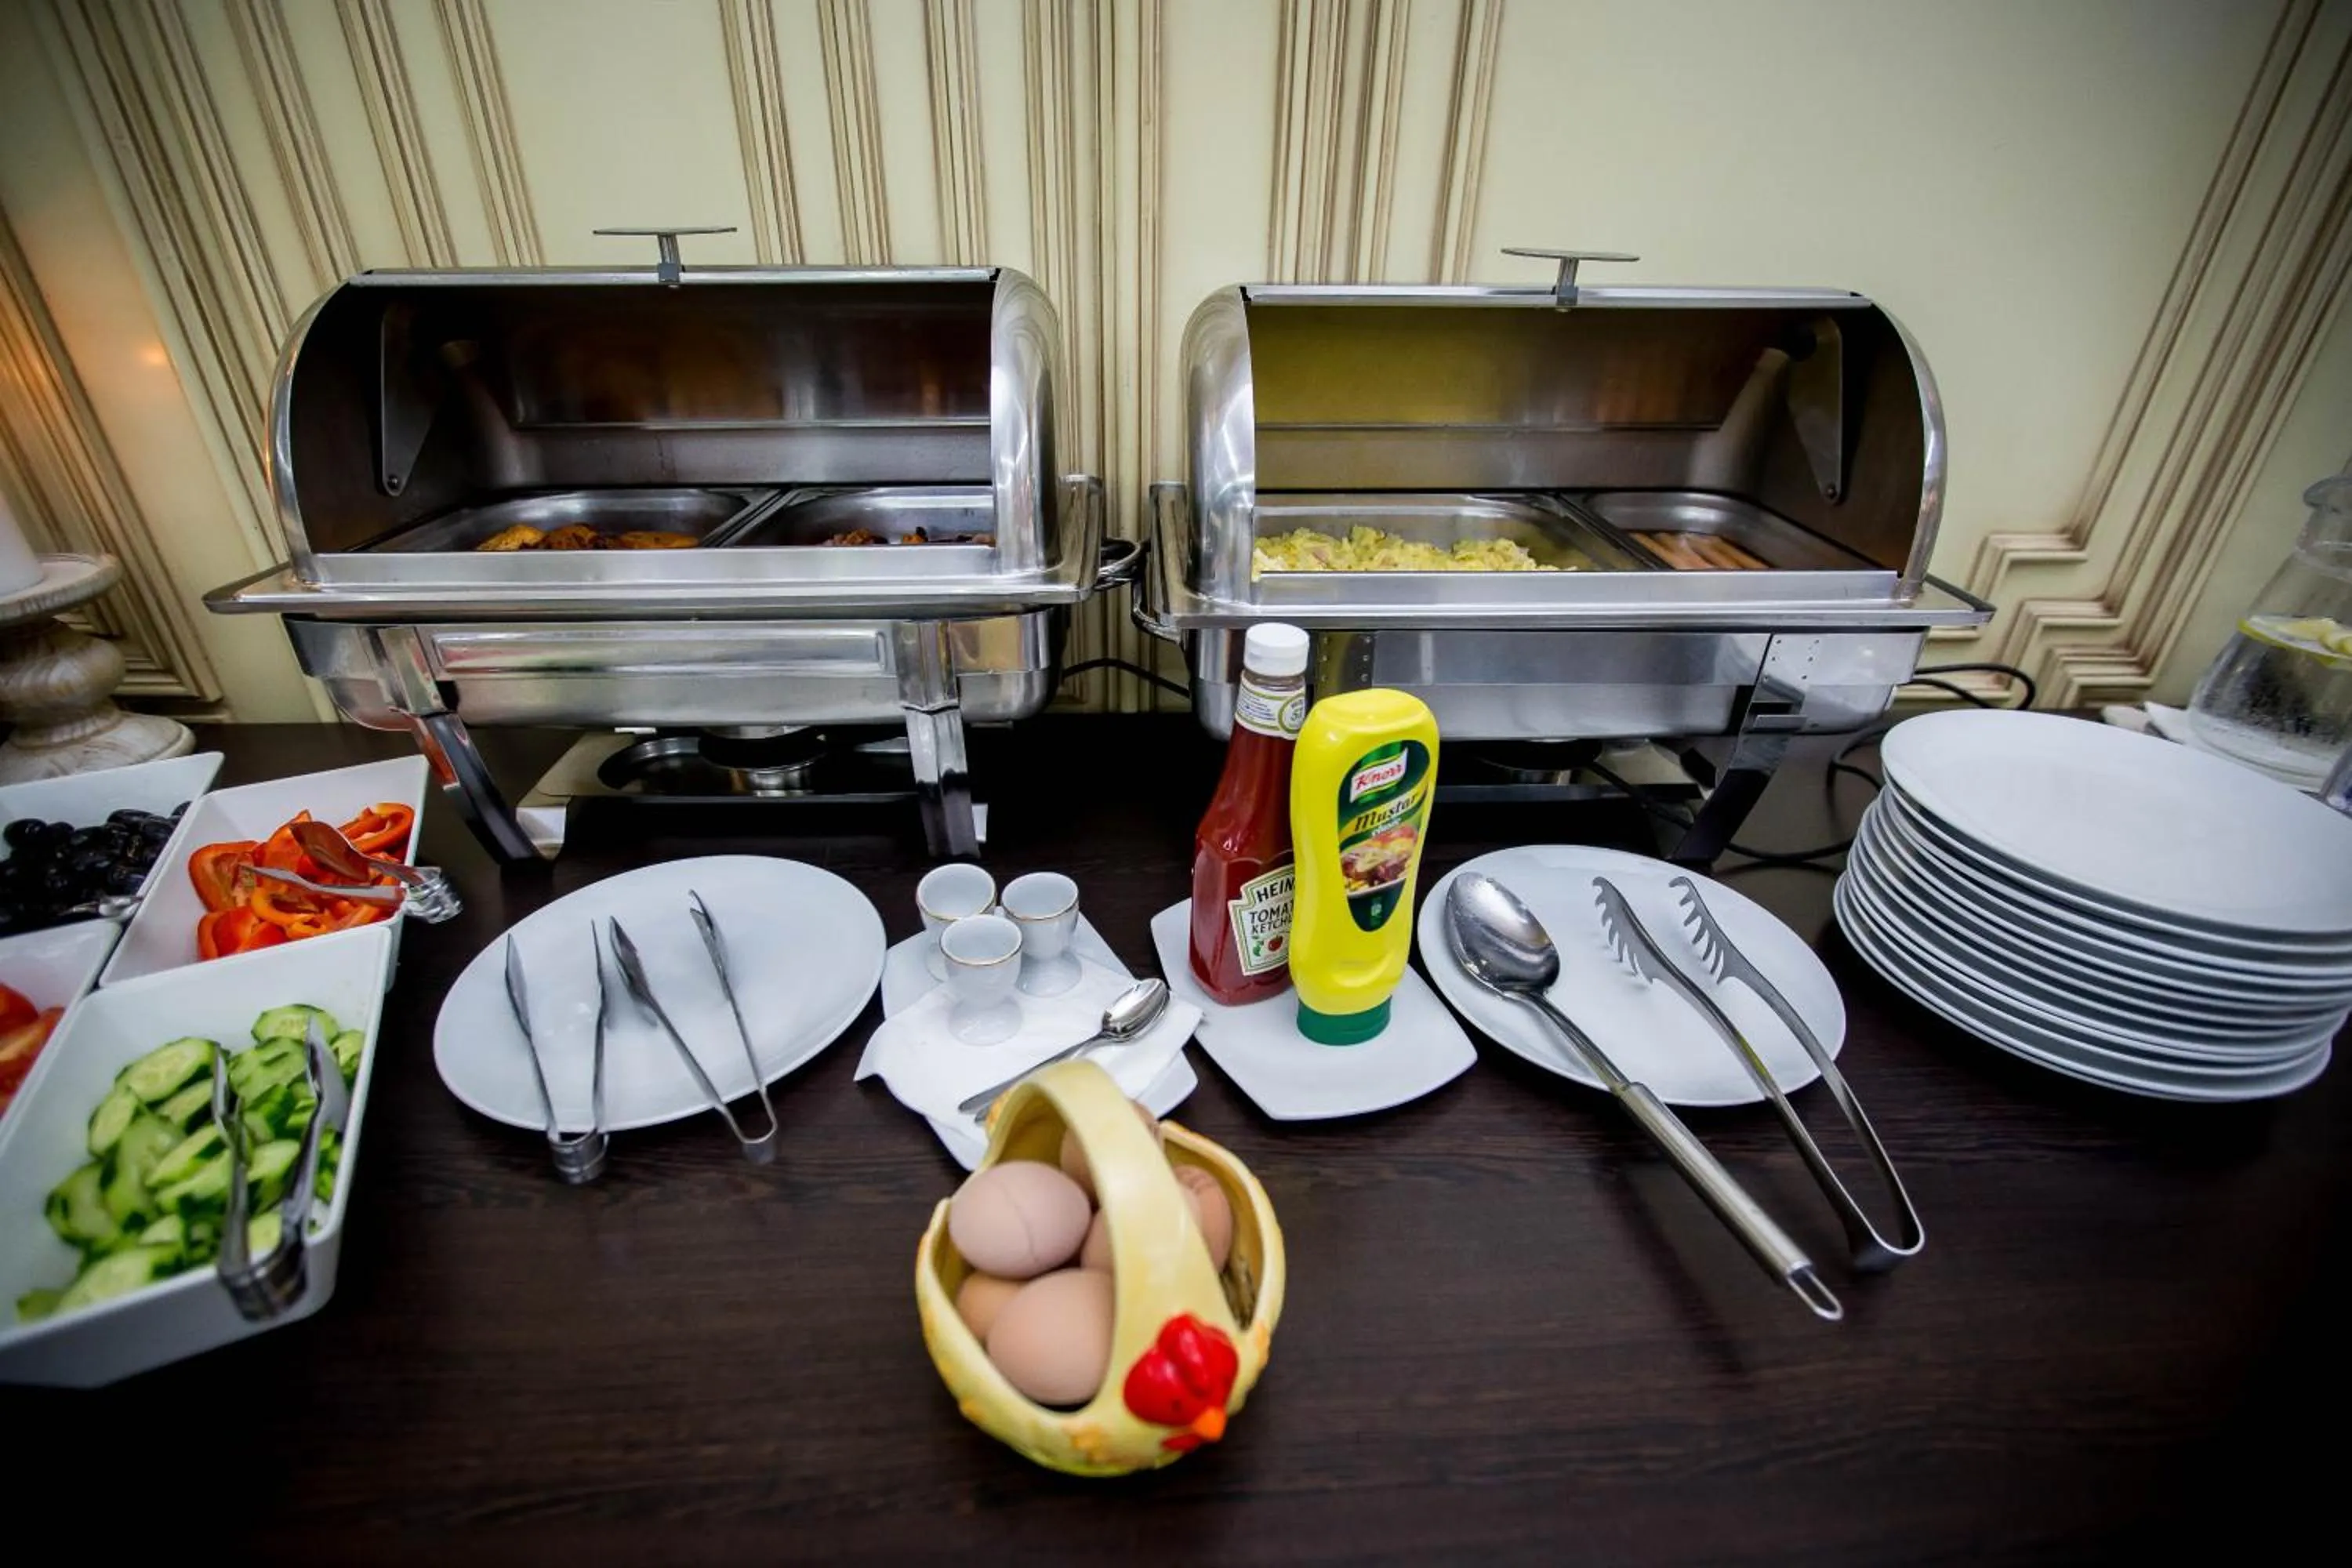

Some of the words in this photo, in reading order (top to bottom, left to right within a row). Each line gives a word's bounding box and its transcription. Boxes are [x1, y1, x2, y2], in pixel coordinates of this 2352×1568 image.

[1356, 764, 1403, 790] Knorr
[1256, 877, 1295, 902] HEIN
[1249, 899, 1294, 924] TOMAT
